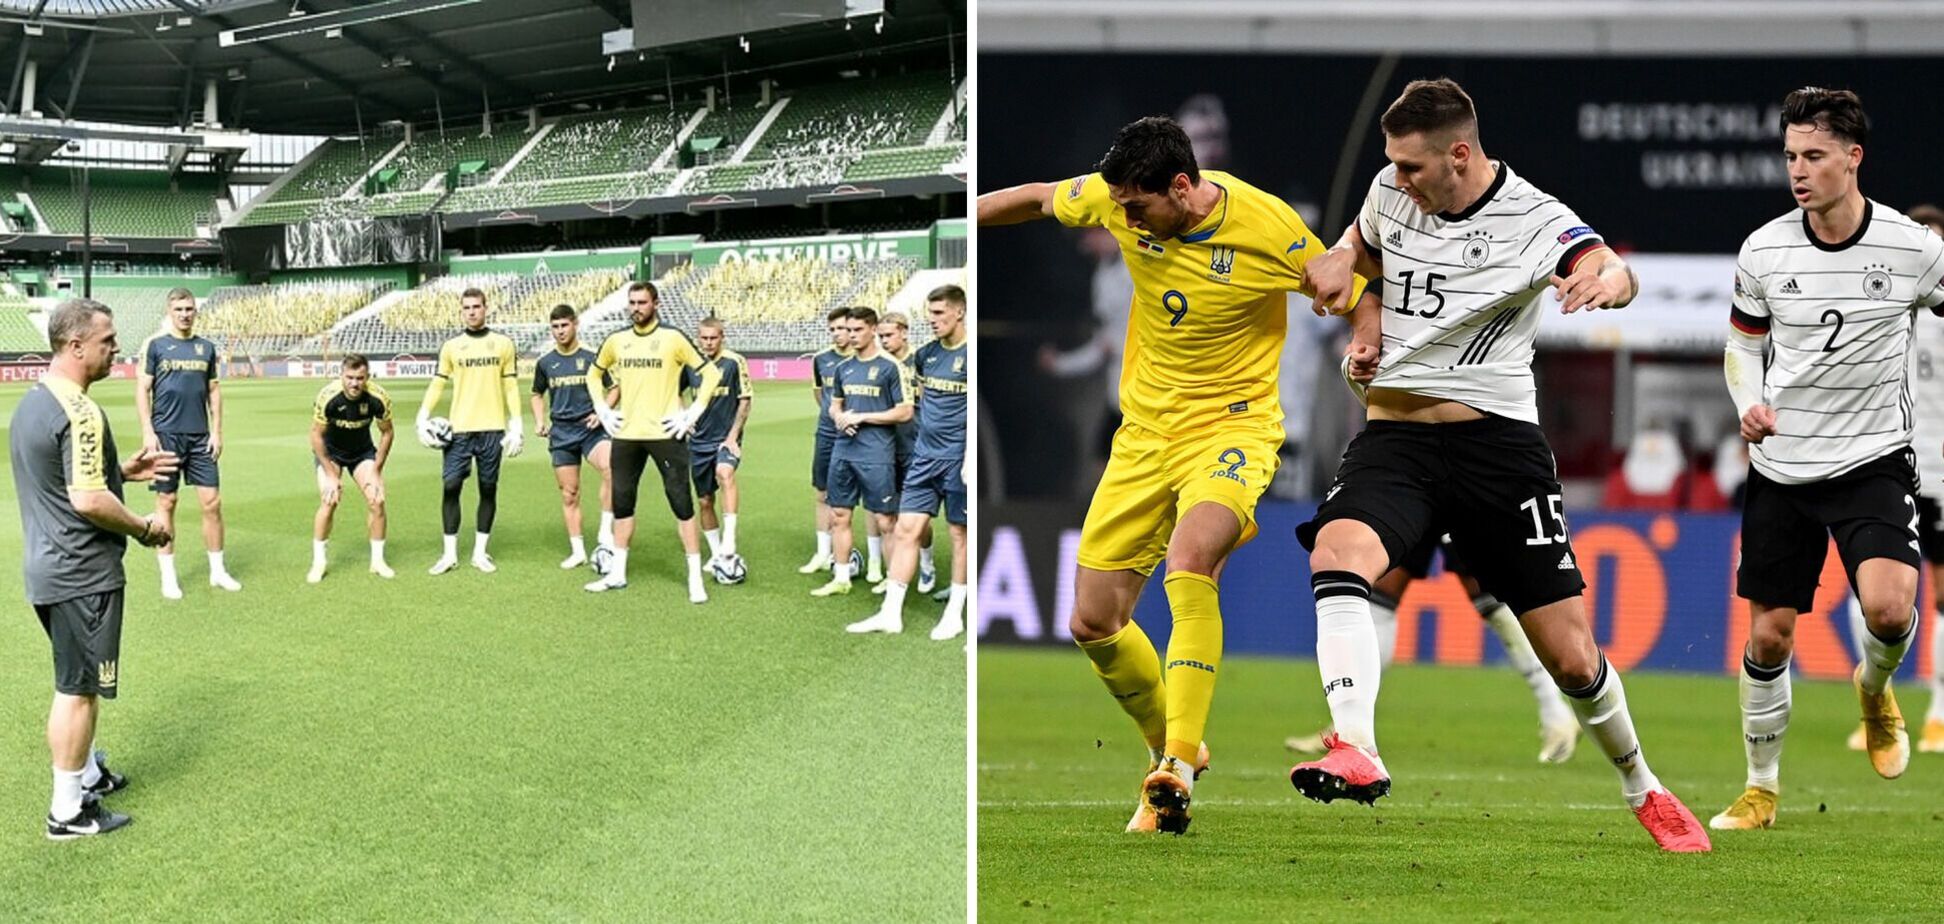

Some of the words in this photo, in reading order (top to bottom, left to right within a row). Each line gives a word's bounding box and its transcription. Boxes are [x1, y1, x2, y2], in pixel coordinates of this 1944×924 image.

[719, 240, 898, 266] OSTKURVE
[1162, 289, 1188, 327] 9
[1395, 271, 1446, 319] 15
[1820, 309, 1846, 352] 2
[1218, 448, 1247, 474] 9
[1520, 494, 1567, 546] 15
[1904, 494, 1920, 537] 2
[1324, 677, 1354, 697] DFB
[1745, 733, 1776, 744] DFB
